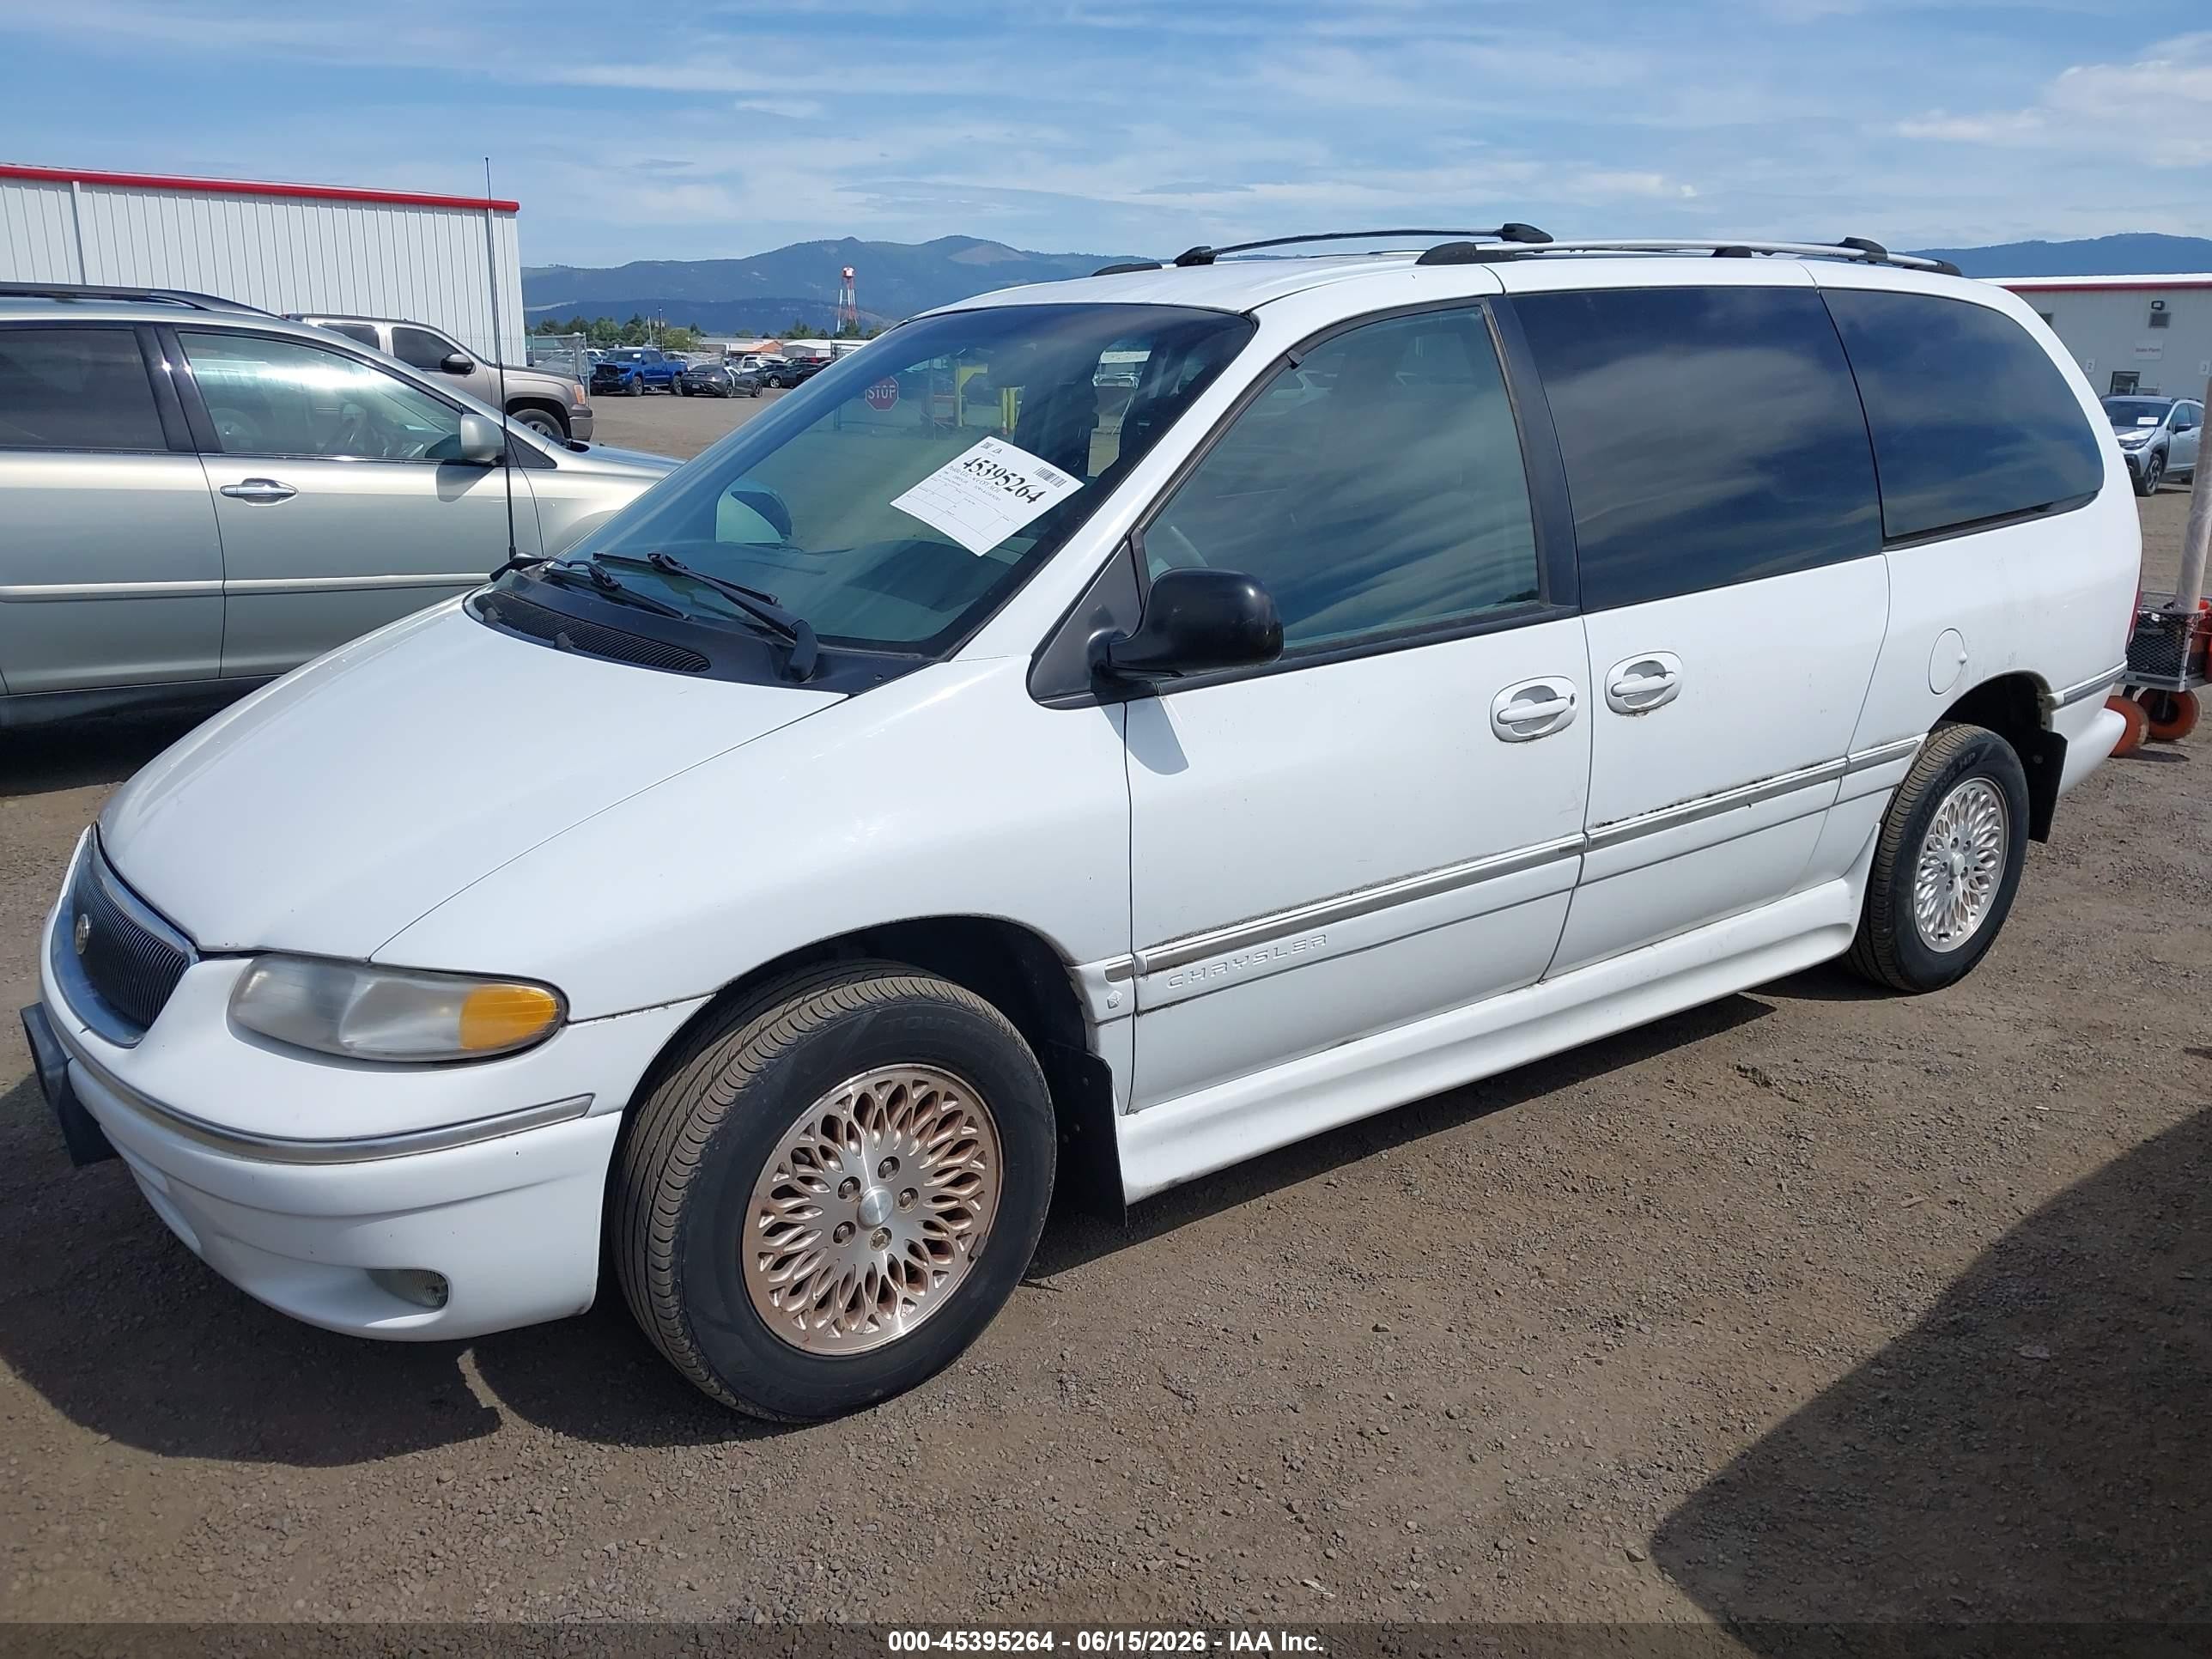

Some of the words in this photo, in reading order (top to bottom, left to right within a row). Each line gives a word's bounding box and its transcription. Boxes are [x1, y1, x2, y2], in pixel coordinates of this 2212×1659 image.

[867, 385, 896, 399] STOP
[963, 456, 1047, 504] 45395264
[1166, 933, 1328, 990] CHRYSLER
